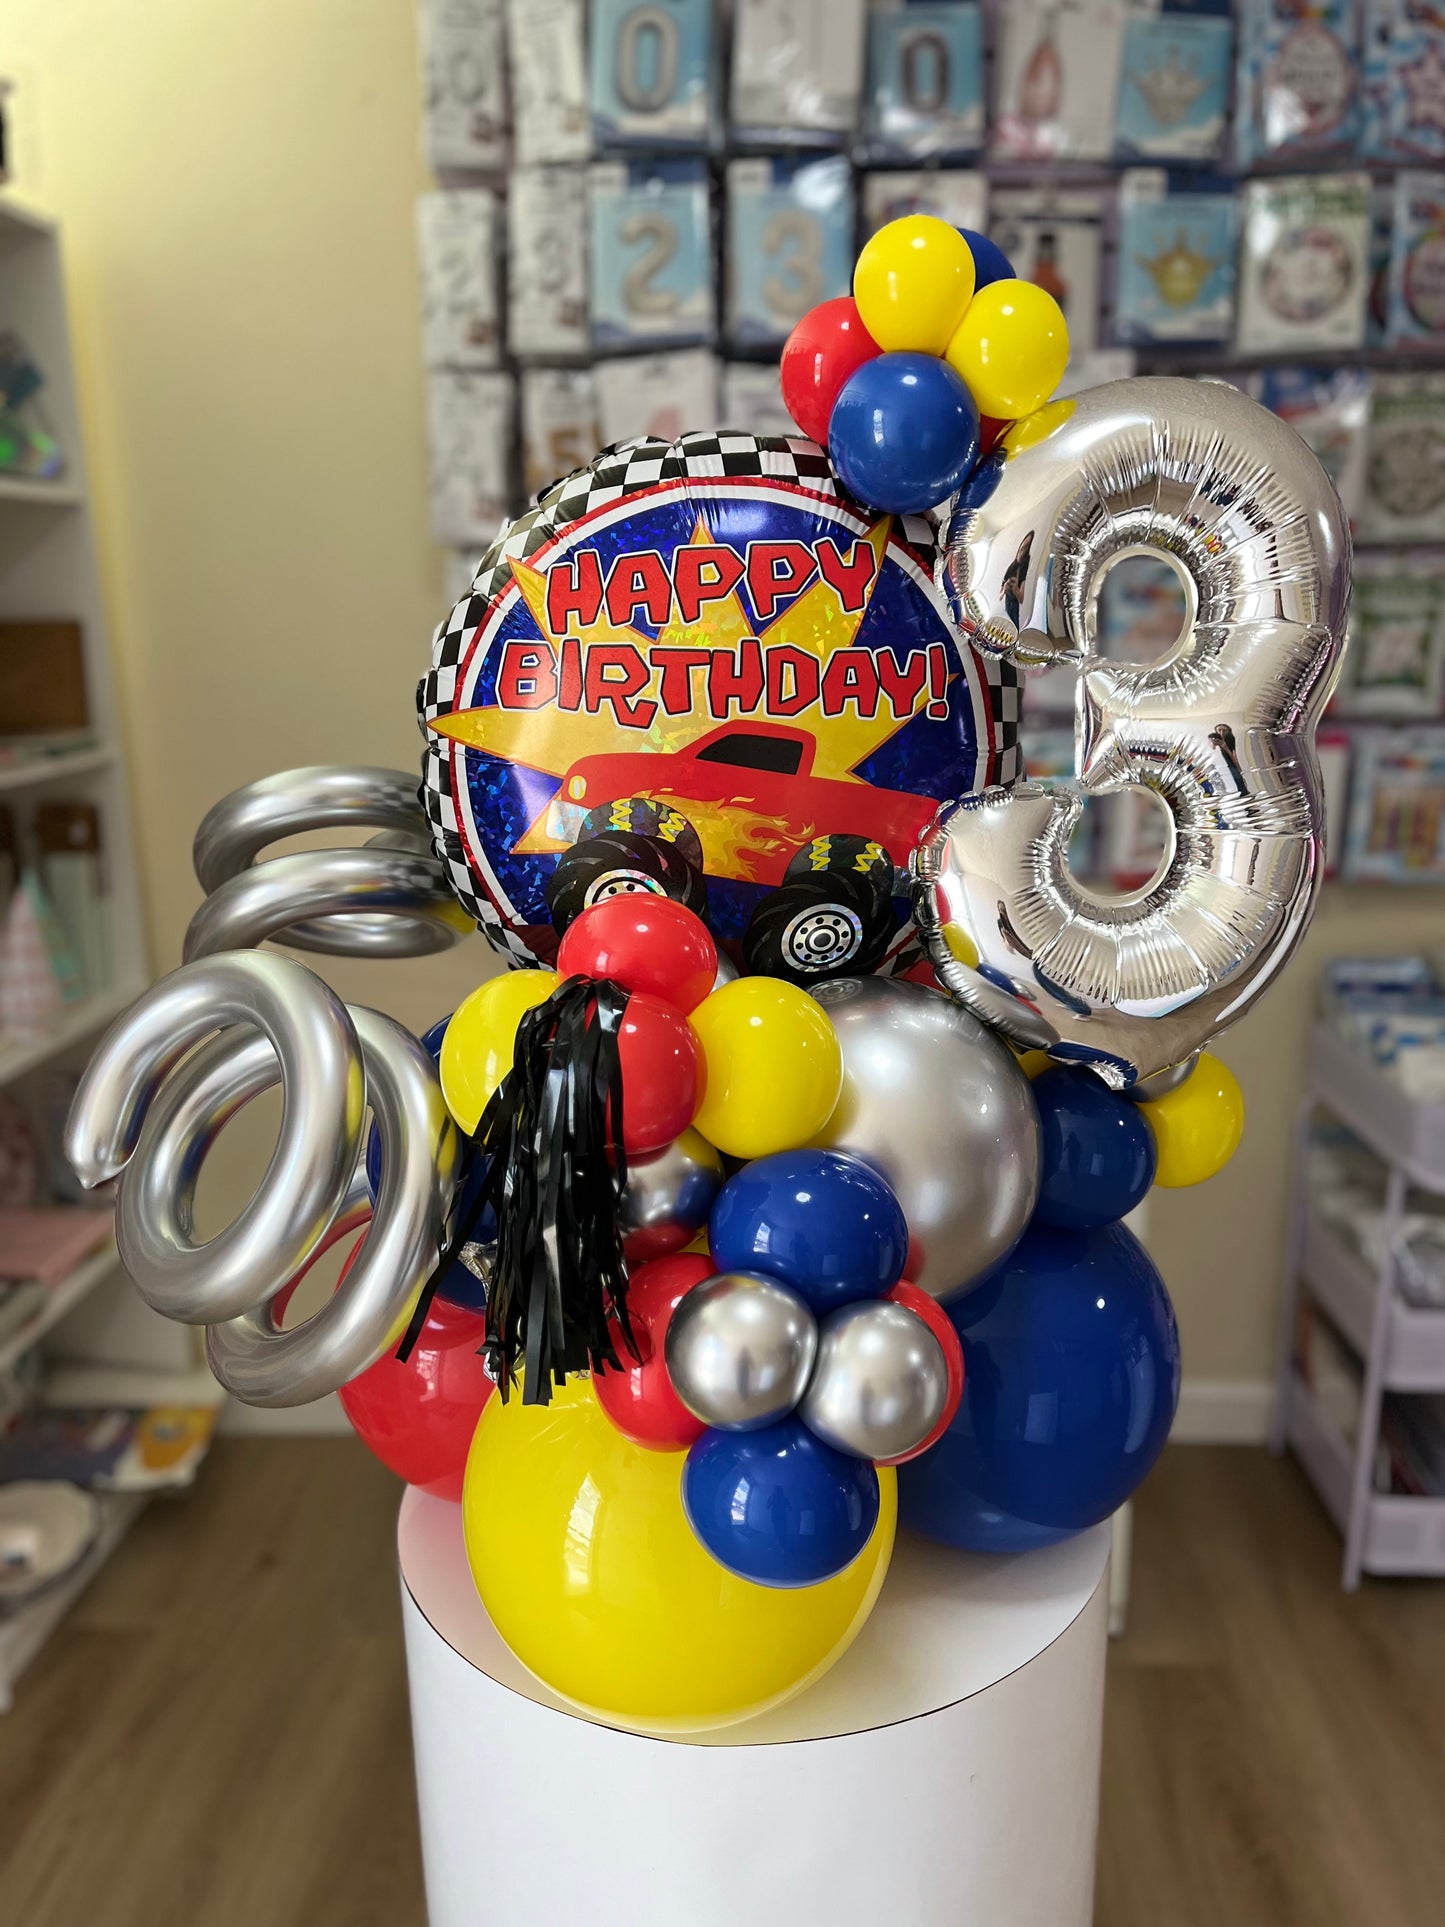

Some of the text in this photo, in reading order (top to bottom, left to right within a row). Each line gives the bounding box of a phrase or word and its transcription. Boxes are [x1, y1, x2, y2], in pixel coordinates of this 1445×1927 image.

[616, 3, 680, 115] 0
[617, 210, 681, 317] 2
[763, 208, 824, 319] 3
[547, 537, 877, 637] HAPPY
[495, 635, 949, 732] BIRTHDAY!
[917, 377, 1352, 1091] 3
